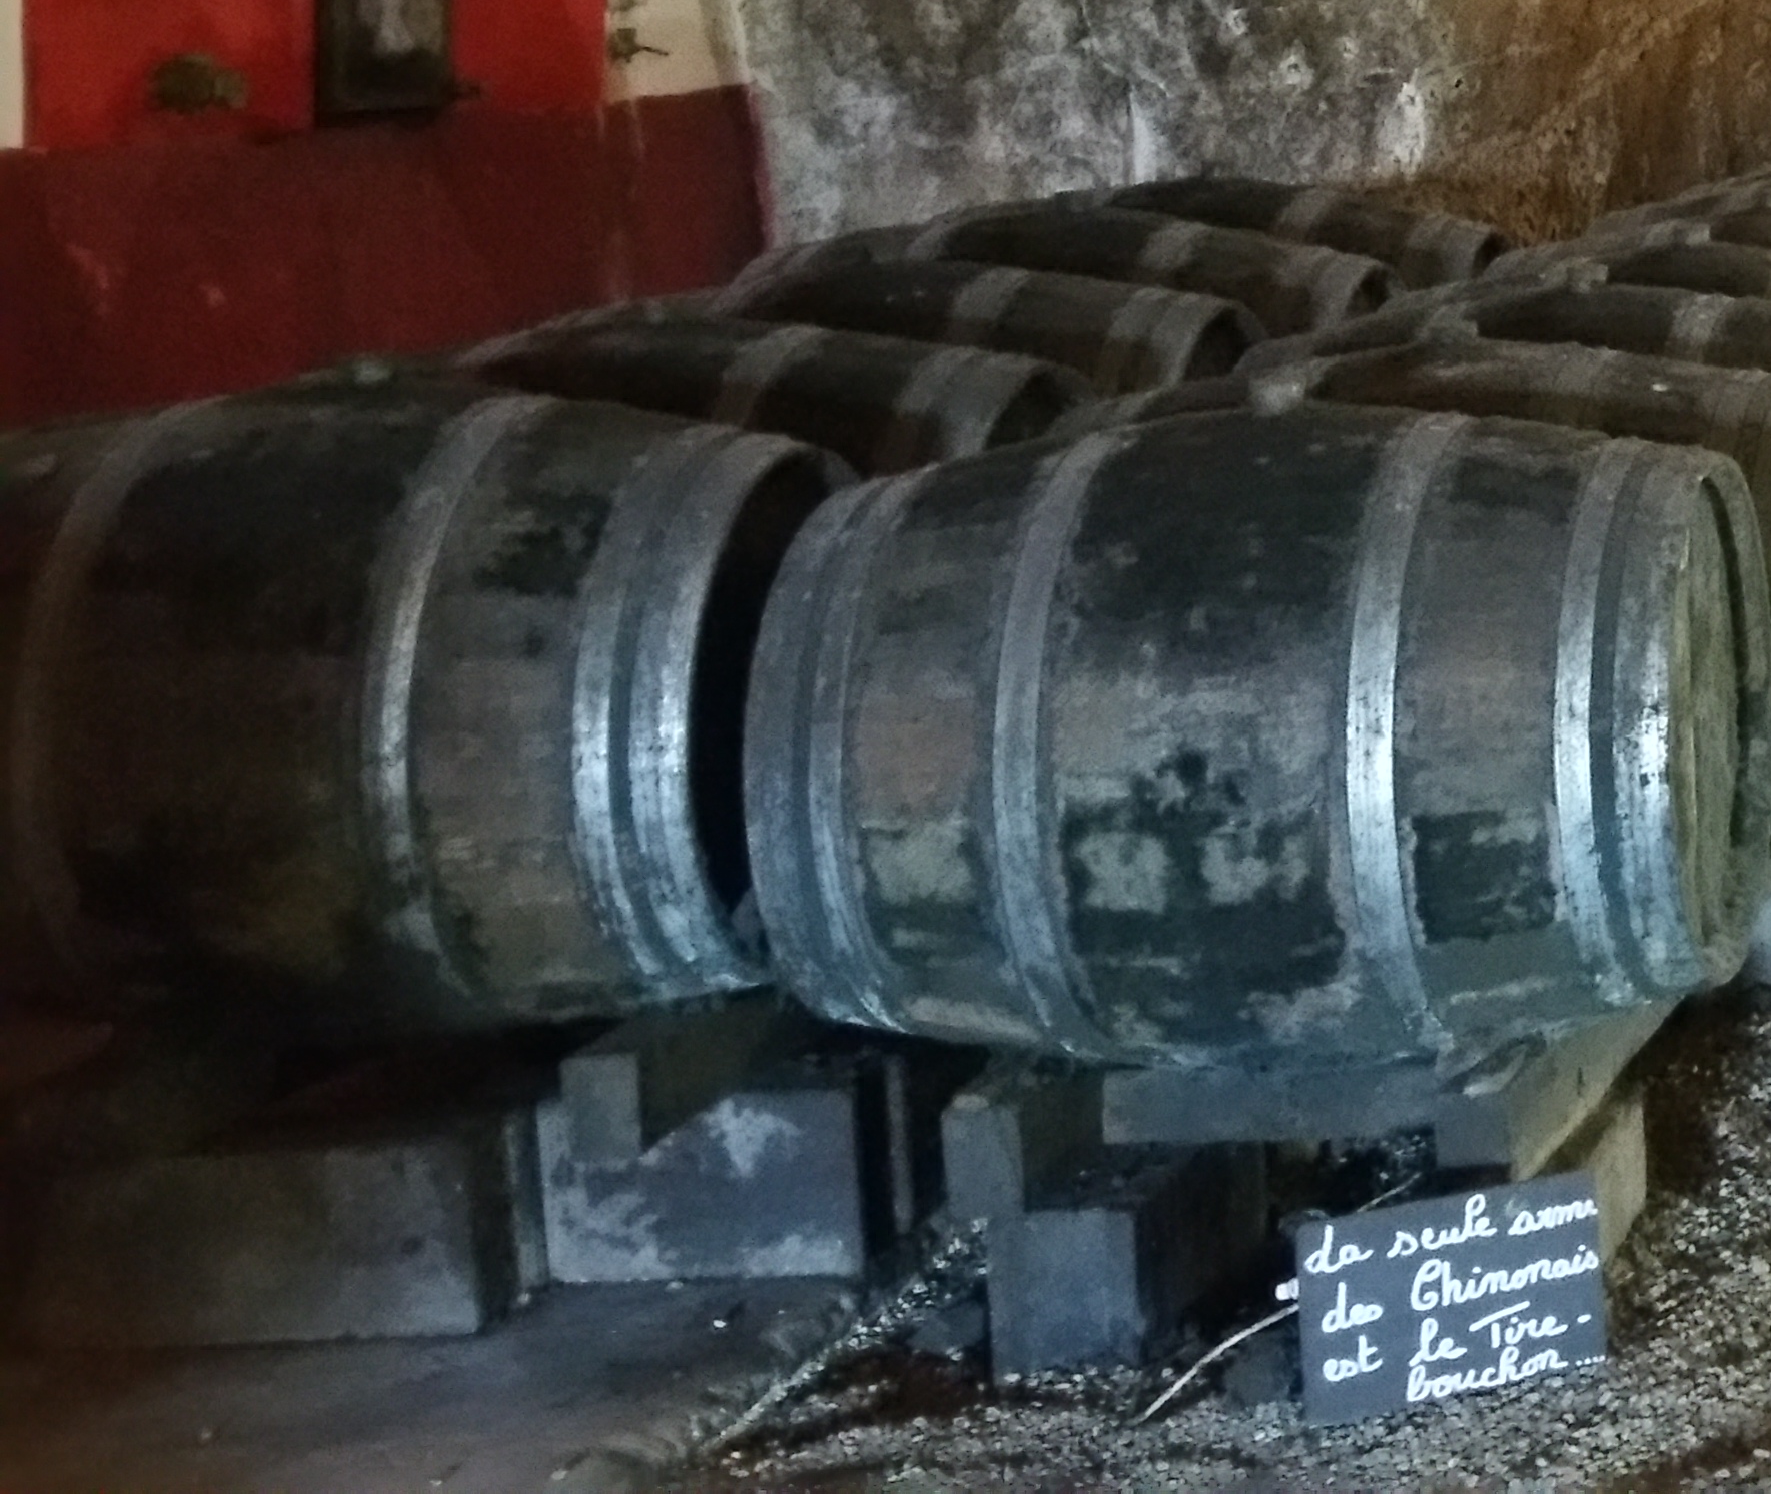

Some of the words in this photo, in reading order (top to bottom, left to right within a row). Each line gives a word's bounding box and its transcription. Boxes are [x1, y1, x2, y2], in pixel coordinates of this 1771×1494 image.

[1387, 1193, 1498, 1258] seule
[1321, 1281, 1384, 1334] des
[1410, 1244, 1599, 1312] Chinonais
[1322, 1334, 1384, 1382] est
